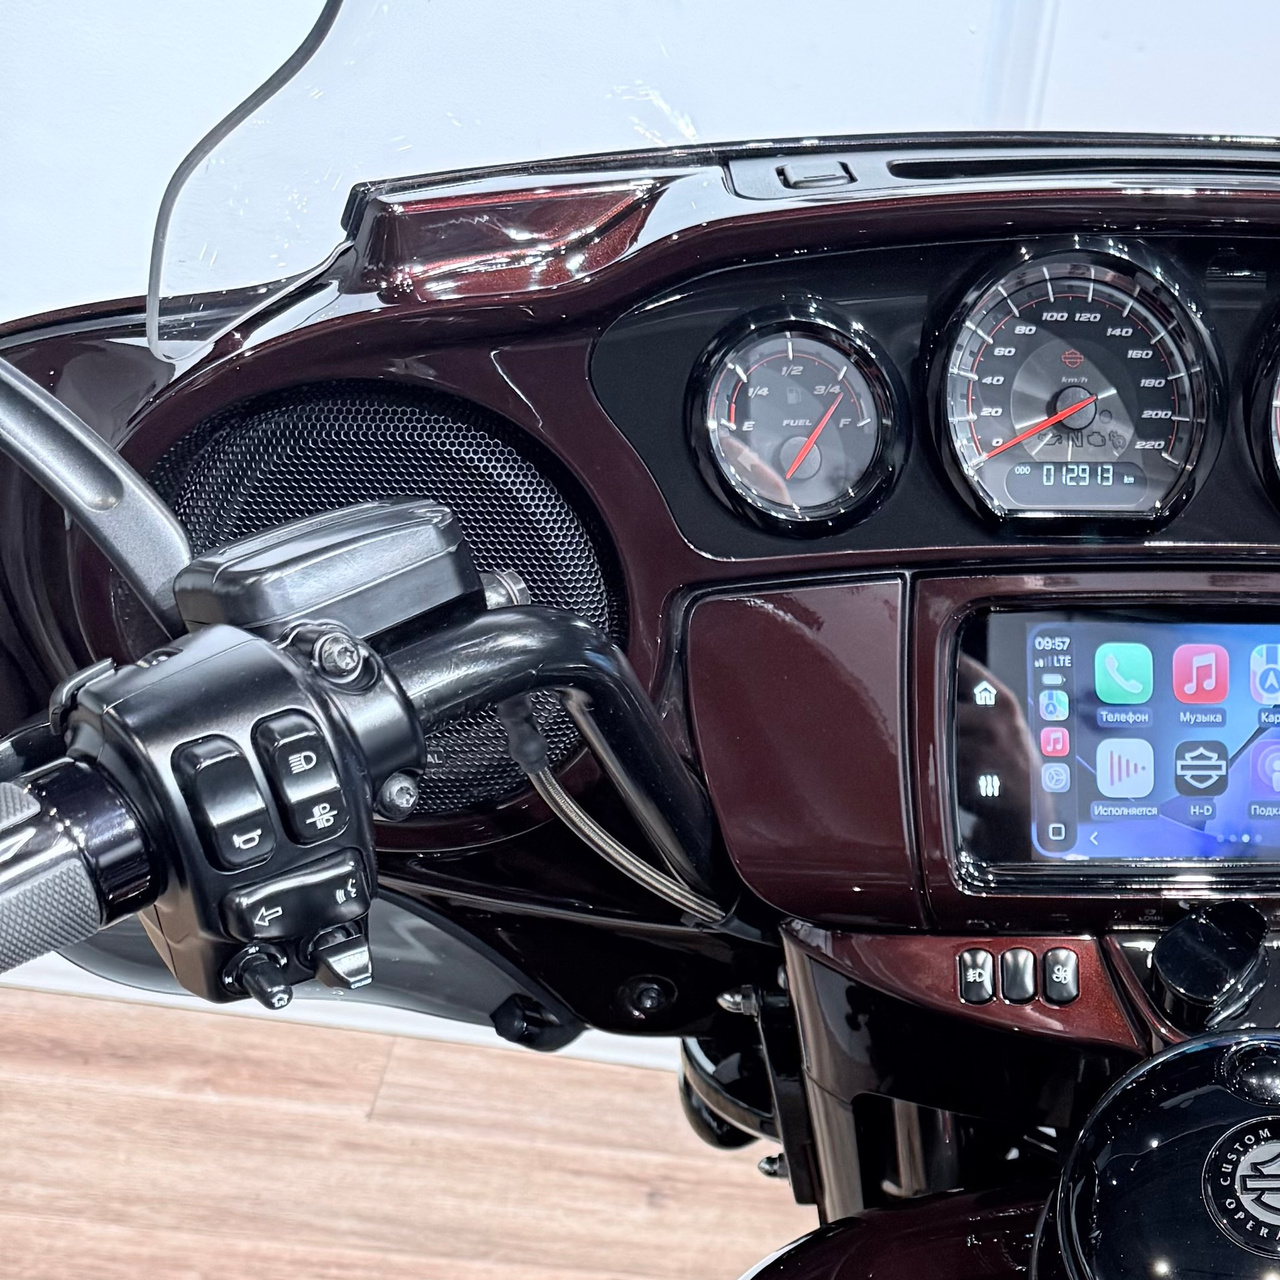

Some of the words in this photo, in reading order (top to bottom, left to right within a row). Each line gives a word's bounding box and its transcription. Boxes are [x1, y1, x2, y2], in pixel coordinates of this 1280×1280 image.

[1042, 312, 1068, 322] 100
[1074, 312, 1101, 322] 120
[1014, 325, 1037, 335] 80
[1106, 327, 1133, 337] 140
[993, 347, 1016, 357] 60
[1127, 349, 1153, 359] 160
[781, 365, 804, 377] 1/2
[981, 376, 1005, 385] 40
[1061, 376, 1088, 384] km/h
[1140, 379, 1166, 388] 180
[747, 386, 769, 398] 1/4
[813, 384, 842, 397] 3/4
[980, 407, 1003, 417] 20
[1141, 410, 1172, 419] 200
[742, 421, 755, 431] E
[783, 419, 813, 427] FUEL
[839, 418, 851, 428] F
[991, 438, 1004, 447] 0
[1134, 441, 1165, 449] 220
[1043, 465, 1114, 486] 012913
[1034, 636, 1071, 651] 09:57
[1053, 655, 1072, 667] LTE
[1100, 711, 1149, 724] Телефон
[1179, 712, 1222, 725] Музыка
[1094, 806, 1158, 816] Исполняется
[1190, 805, 1213, 816] H-D
[1220, 1128, 1272, 1186] CUSTOM
